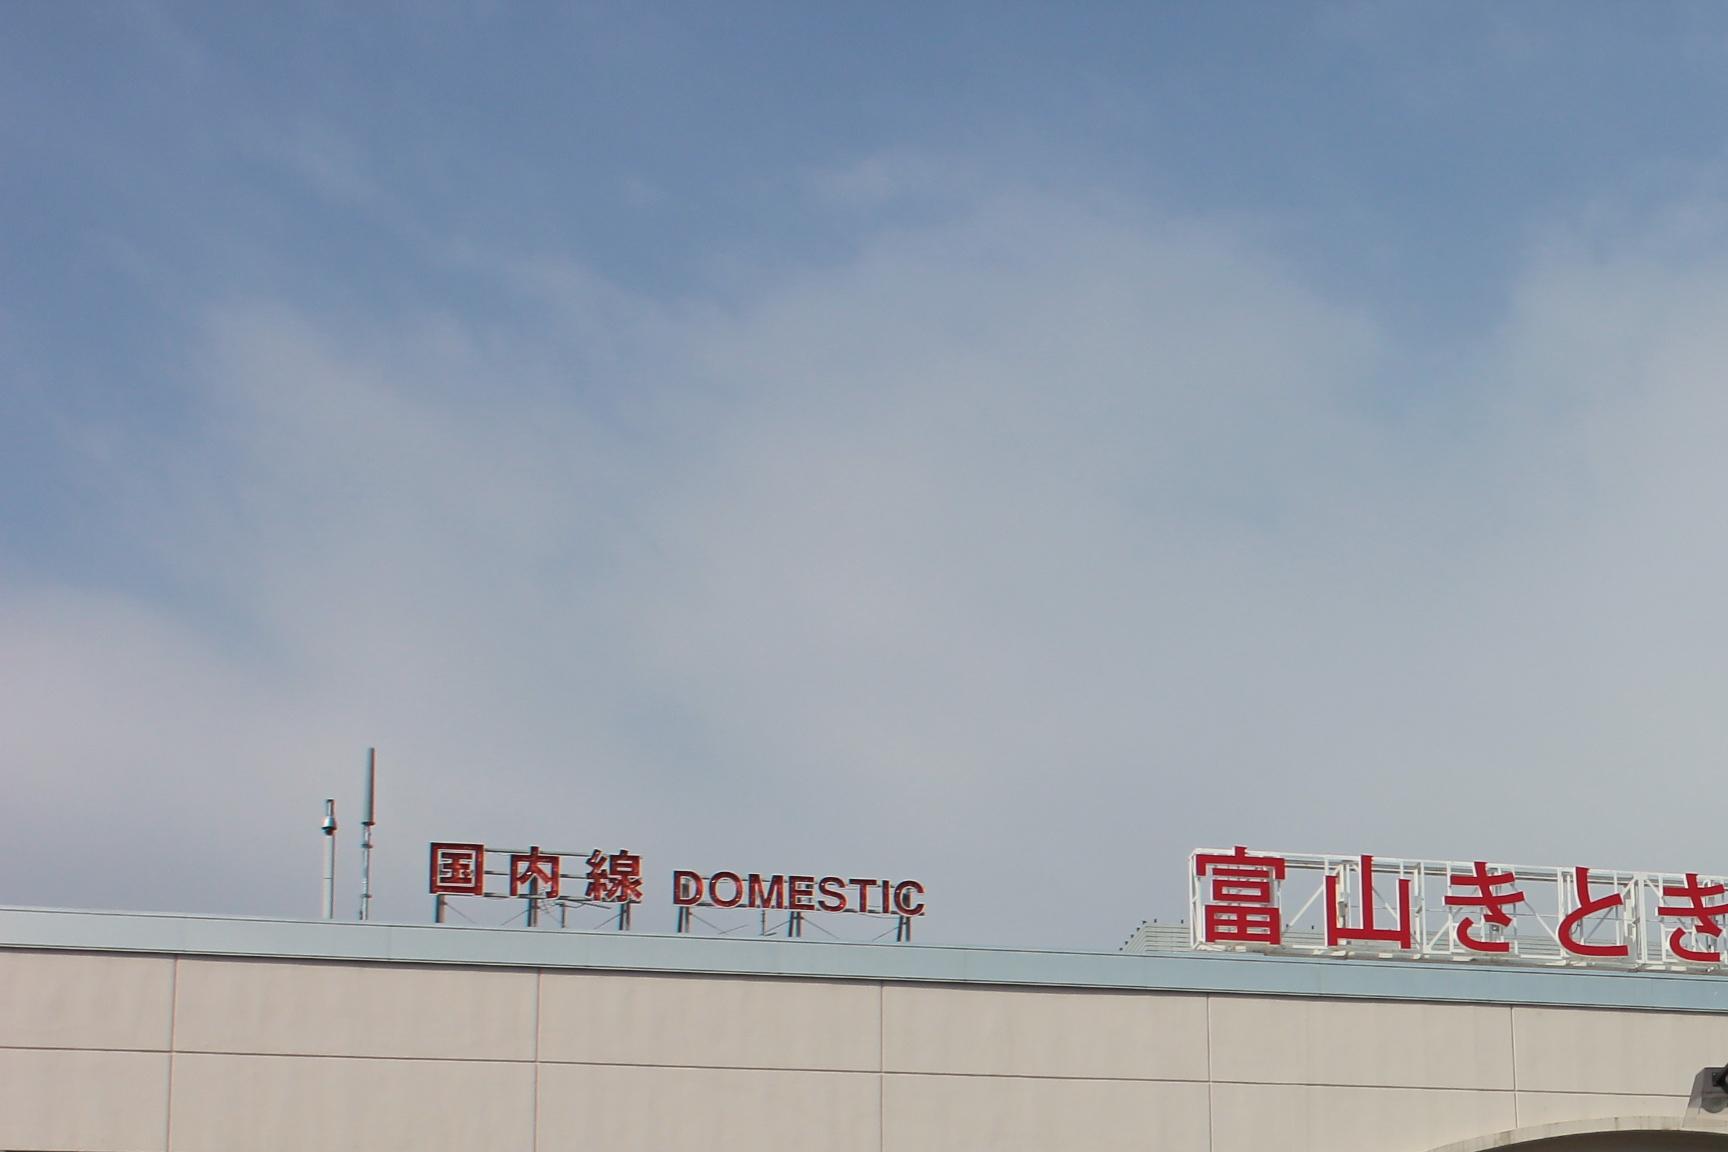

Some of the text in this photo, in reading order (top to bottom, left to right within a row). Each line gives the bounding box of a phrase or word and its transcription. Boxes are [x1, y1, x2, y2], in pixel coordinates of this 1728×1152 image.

[429, 842, 642, 903] 国内線
[672, 869, 925, 916] DOMESTIC
